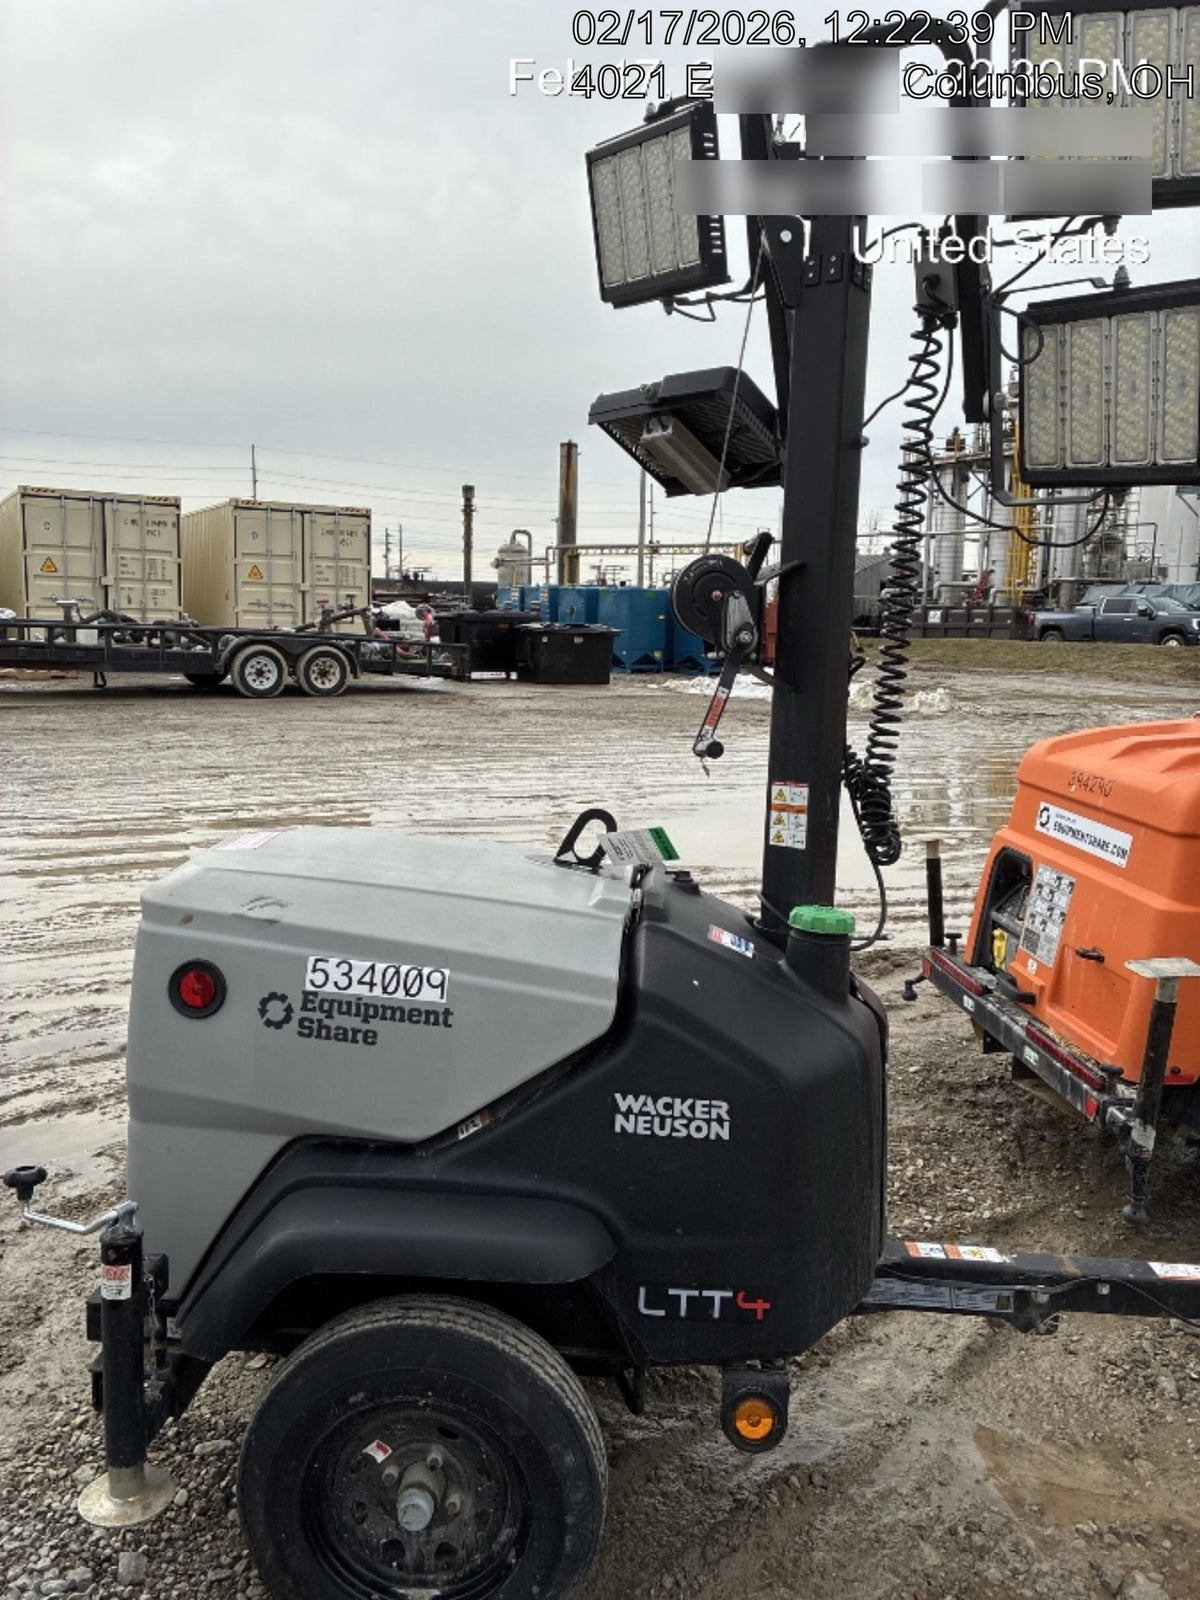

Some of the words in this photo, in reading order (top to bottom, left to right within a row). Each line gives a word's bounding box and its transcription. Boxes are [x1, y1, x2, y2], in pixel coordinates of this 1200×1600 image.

[308, 957, 447, 1000] 534009
[300, 990, 454, 1028] Equipment
[296, 1016, 378, 1046] Share
[614, 1092, 732, 1121] WACKER
[614, 1113, 731, 1141] NEUSON
[637, 1286, 772, 1321] LTT4
